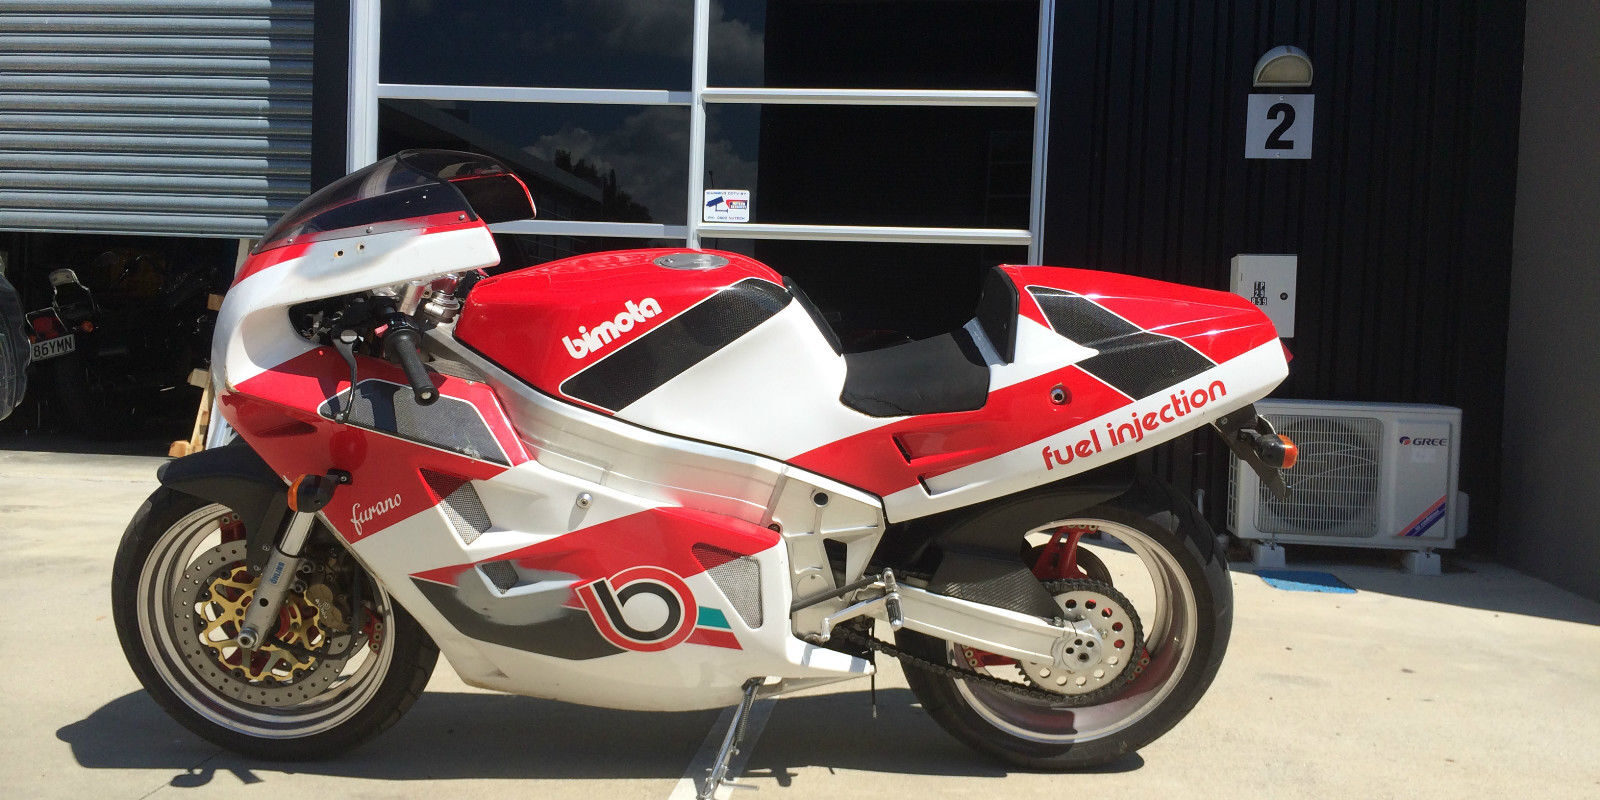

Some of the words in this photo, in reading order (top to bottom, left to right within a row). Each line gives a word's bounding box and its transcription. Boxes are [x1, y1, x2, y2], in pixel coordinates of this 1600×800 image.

[1265, 103, 1295, 149] 2
[33, 336, 73, 358] 86YMN
[561, 297, 663, 359] bimota
[1042, 428, 1103, 470] fuel
[1106, 380, 1227, 447] injection
[1413, 438, 1447, 446] GREE
[350, 494, 402, 535] furano
